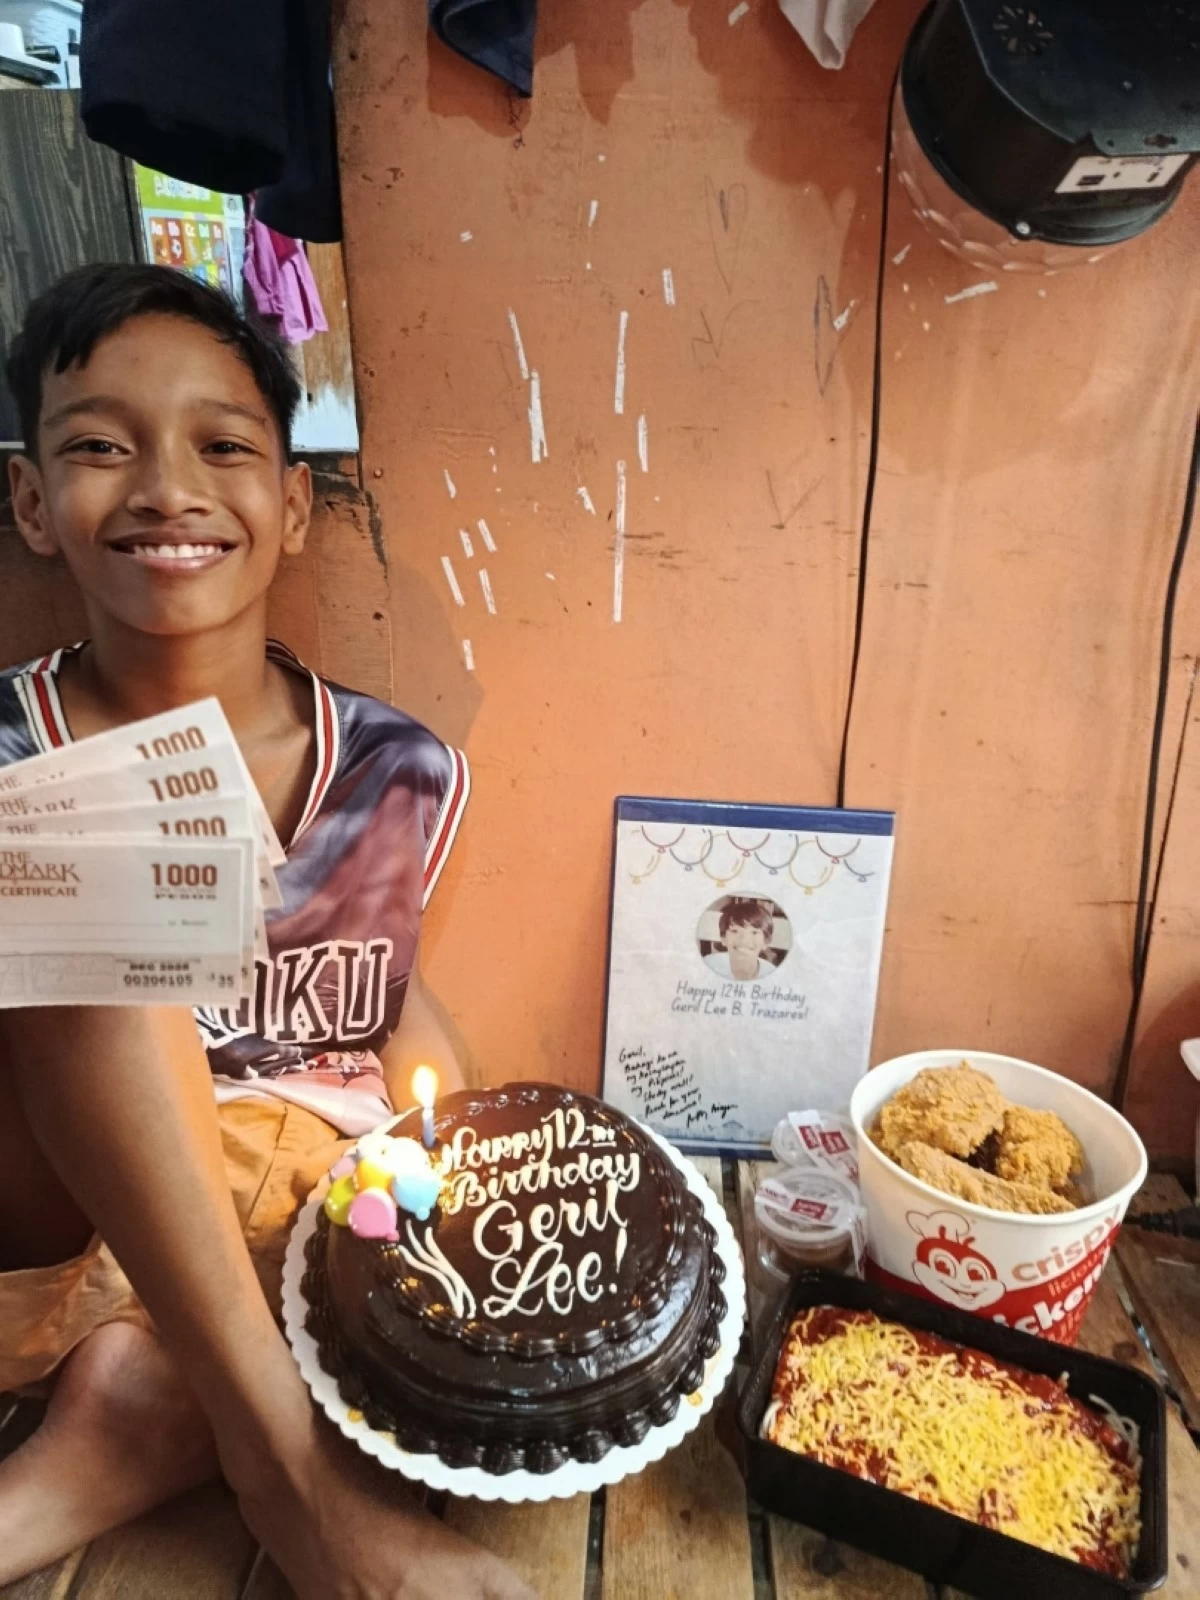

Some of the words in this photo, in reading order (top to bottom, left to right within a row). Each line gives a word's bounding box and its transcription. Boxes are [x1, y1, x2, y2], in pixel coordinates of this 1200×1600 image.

[136, 726, 205, 760] 1000
[148, 767, 218, 802] 1000
[159, 815, 227, 836] 1000
[2, 850, 32, 865] THE
[1, 886, 78, 898] CERTIFICATE
[151, 863, 218, 887] 1000
[671, 997, 700, 1013] Geril
[704, 999, 727, 1014] Lee
[676, 980, 717, 1003] Happy
[721, 983, 746, 998] 12th
[750, 984, 806, 1008] Birthday
[440, 1126, 553, 1173] Happy
[446, 1150, 641, 1216] Birthday
[473, 1178, 628, 1261] Geril
[1011, 1203, 1121, 1282] crispy
[483, 1227, 628, 1319] Lee!
